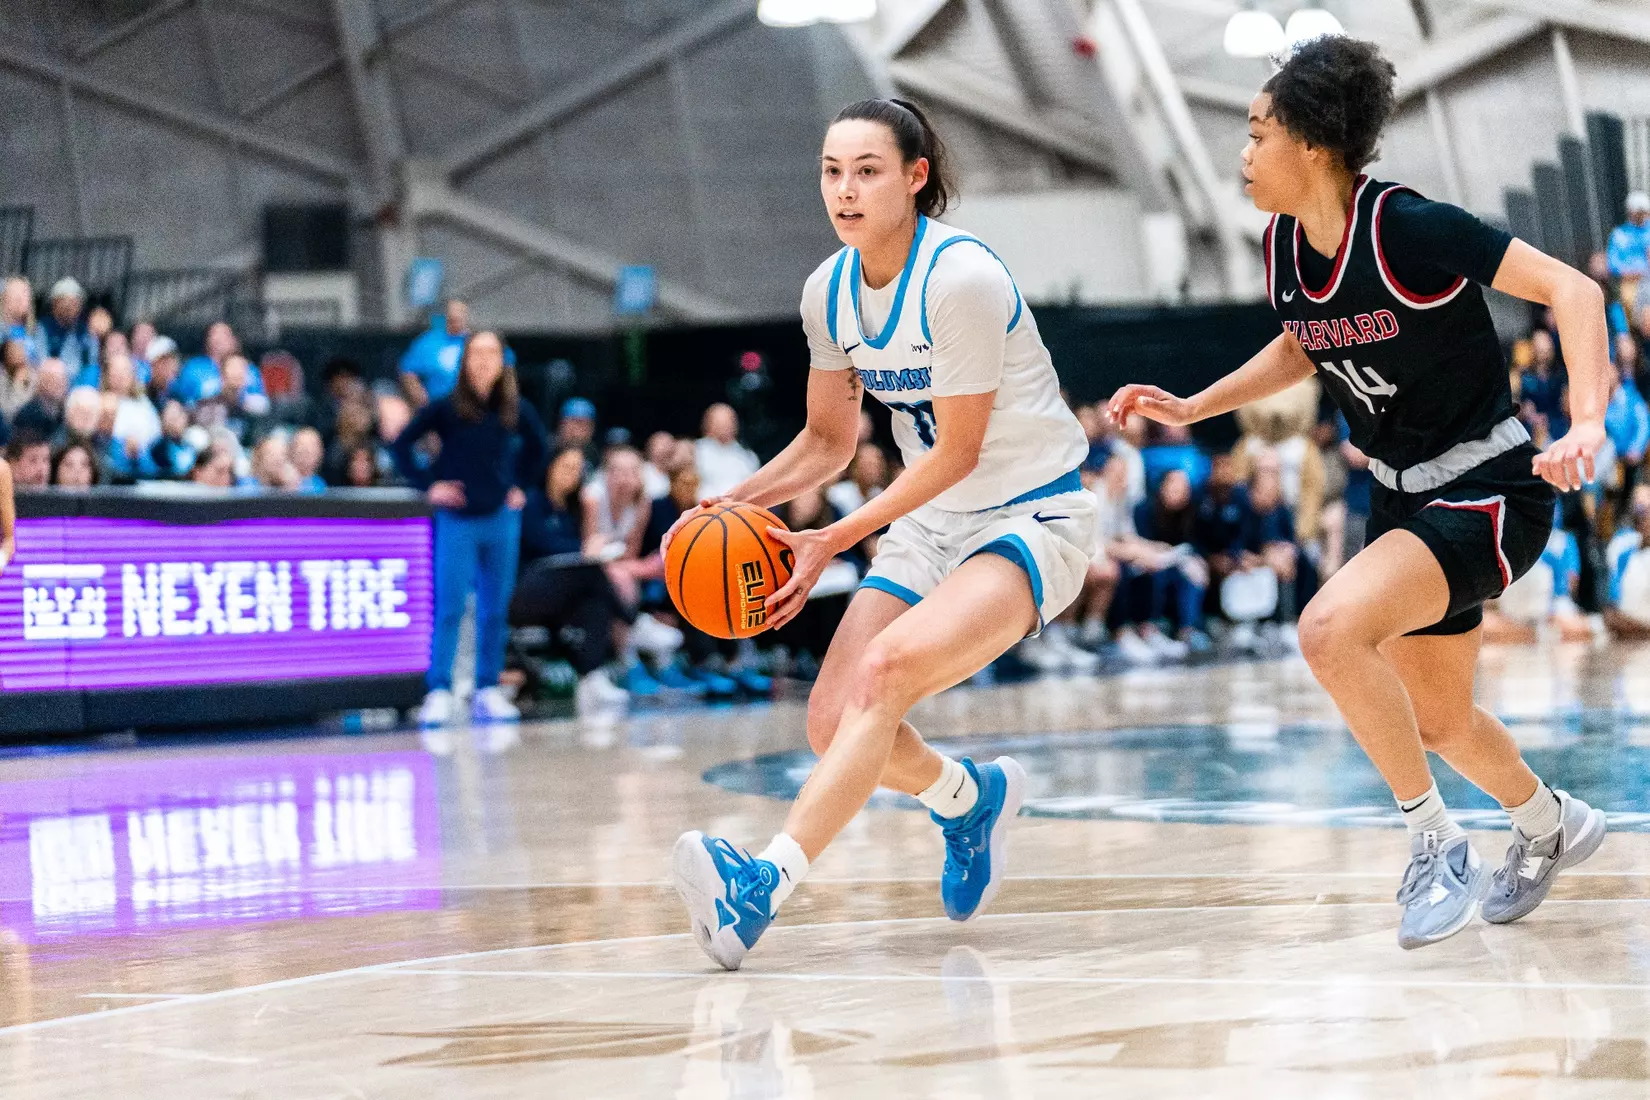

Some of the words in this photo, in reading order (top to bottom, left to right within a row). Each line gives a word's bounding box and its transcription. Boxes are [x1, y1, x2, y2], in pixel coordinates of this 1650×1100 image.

[855, 366, 932, 391] OLUMBI
[1320, 359, 1398, 415] 14
[121, 560, 292, 638] NEXEN
[299, 558, 410, 632] TIRE
[742, 560, 767, 628] ELITE
